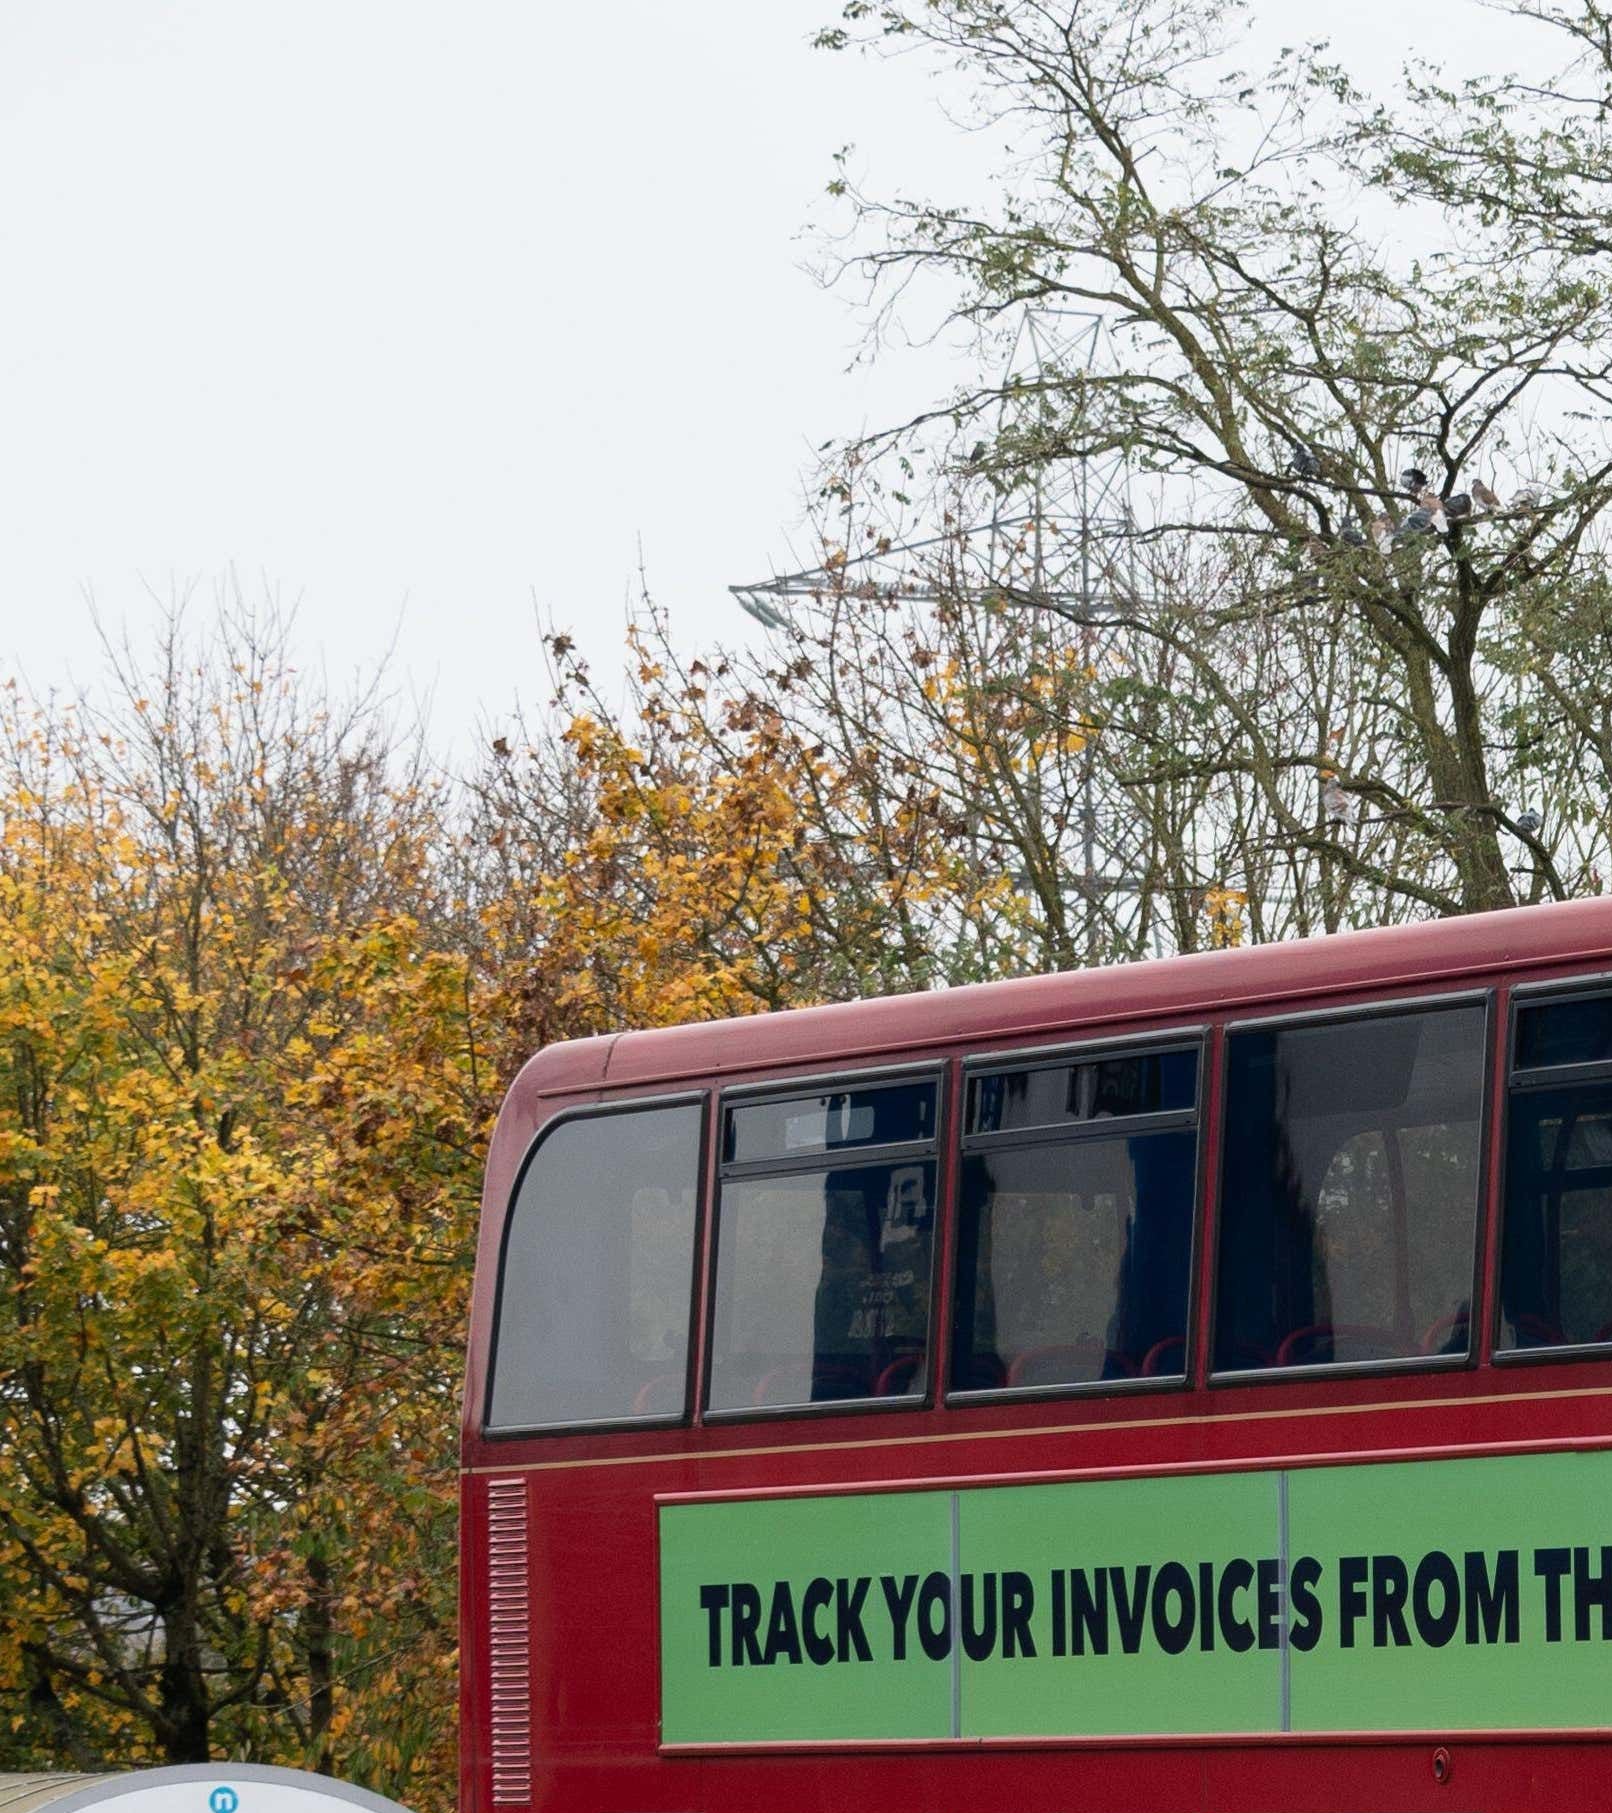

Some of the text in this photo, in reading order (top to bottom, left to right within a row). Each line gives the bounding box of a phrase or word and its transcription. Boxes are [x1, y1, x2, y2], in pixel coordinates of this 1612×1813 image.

[700, 1576, 874, 1668] TRACK
[881, 1571, 1036, 1662] YOUR
[1052, 1556, 1322, 1657] INVOICES
[1339, 1549, 1519, 1648] FROM
